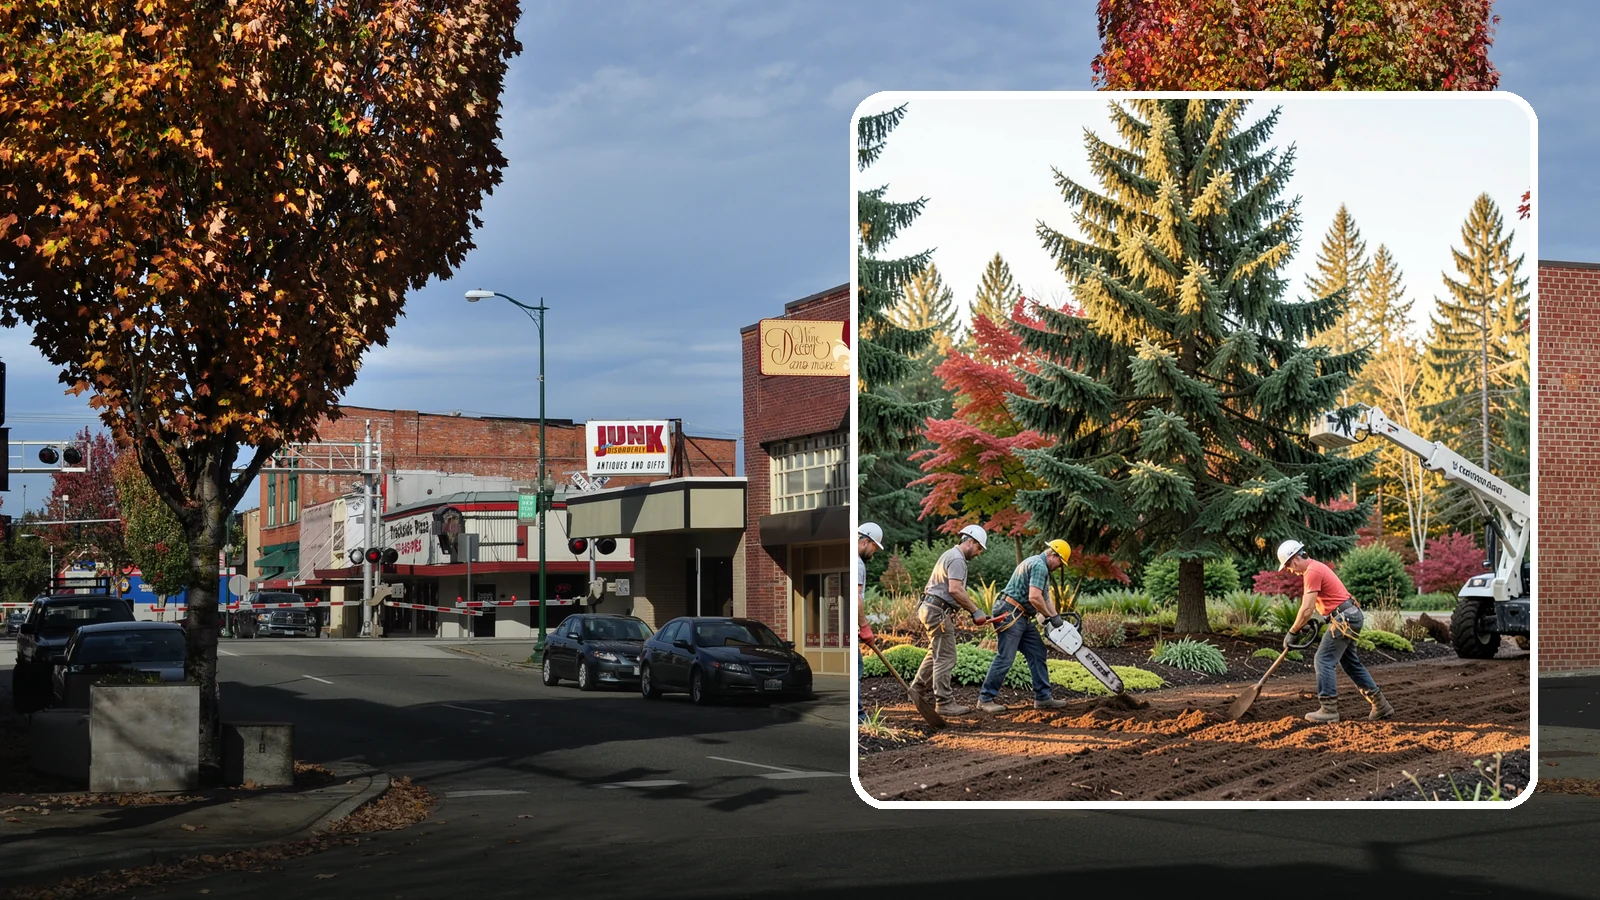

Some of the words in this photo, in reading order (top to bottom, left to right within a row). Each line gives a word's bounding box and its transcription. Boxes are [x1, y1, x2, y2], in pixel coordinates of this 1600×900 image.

[765, 327, 831, 366] Decor
[595, 425, 664, 457] JUNK
[607, 446, 646, 454] DISORDERLY
[596, 461, 628, 470] ANTIQUES
[631, 461, 644, 470] AND
[647, 460, 665, 470] GIFTS
[390, 522, 412, 539] Trackside
[414, 519, 429, 534] Pizza
